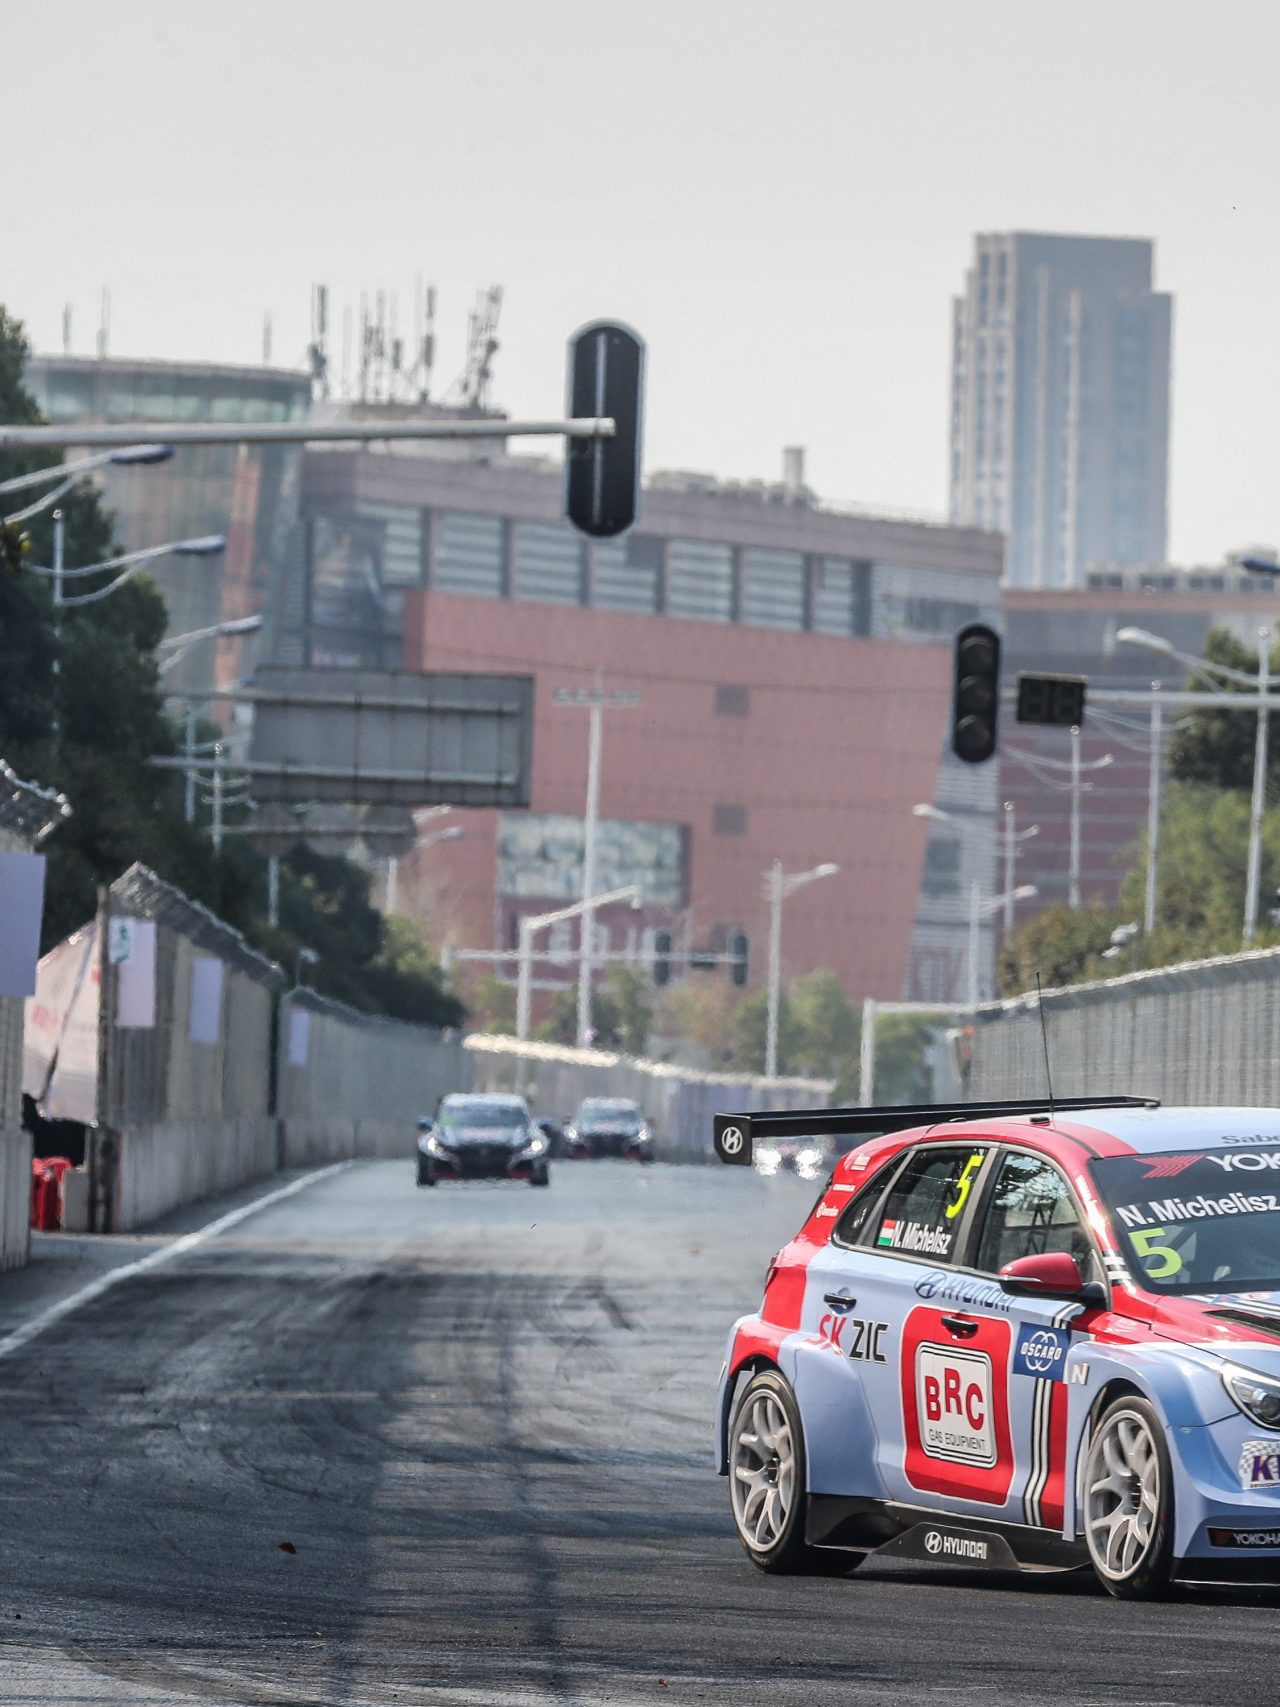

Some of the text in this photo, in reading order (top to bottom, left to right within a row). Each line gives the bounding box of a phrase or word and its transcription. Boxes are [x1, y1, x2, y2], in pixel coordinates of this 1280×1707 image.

[945, 1154, 986, 1218] 5
[1115, 1204, 1156, 1228] N.
[890, 1220, 953, 1255] N. Michelisz
[1127, 1227, 1183, 1278] 5
[939, 1277, 1017, 1313] HYUNDAI
[804, 1314, 892, 1365] SK ZIC
[1020, 1342, 1063, 1361] OSCARO
[924, 1367, 985, 1431] BRC
[928, 1428, 986, 1452] GAS EQUIPMENT
[943, 1536, 987, 1560] HYUNDAI
